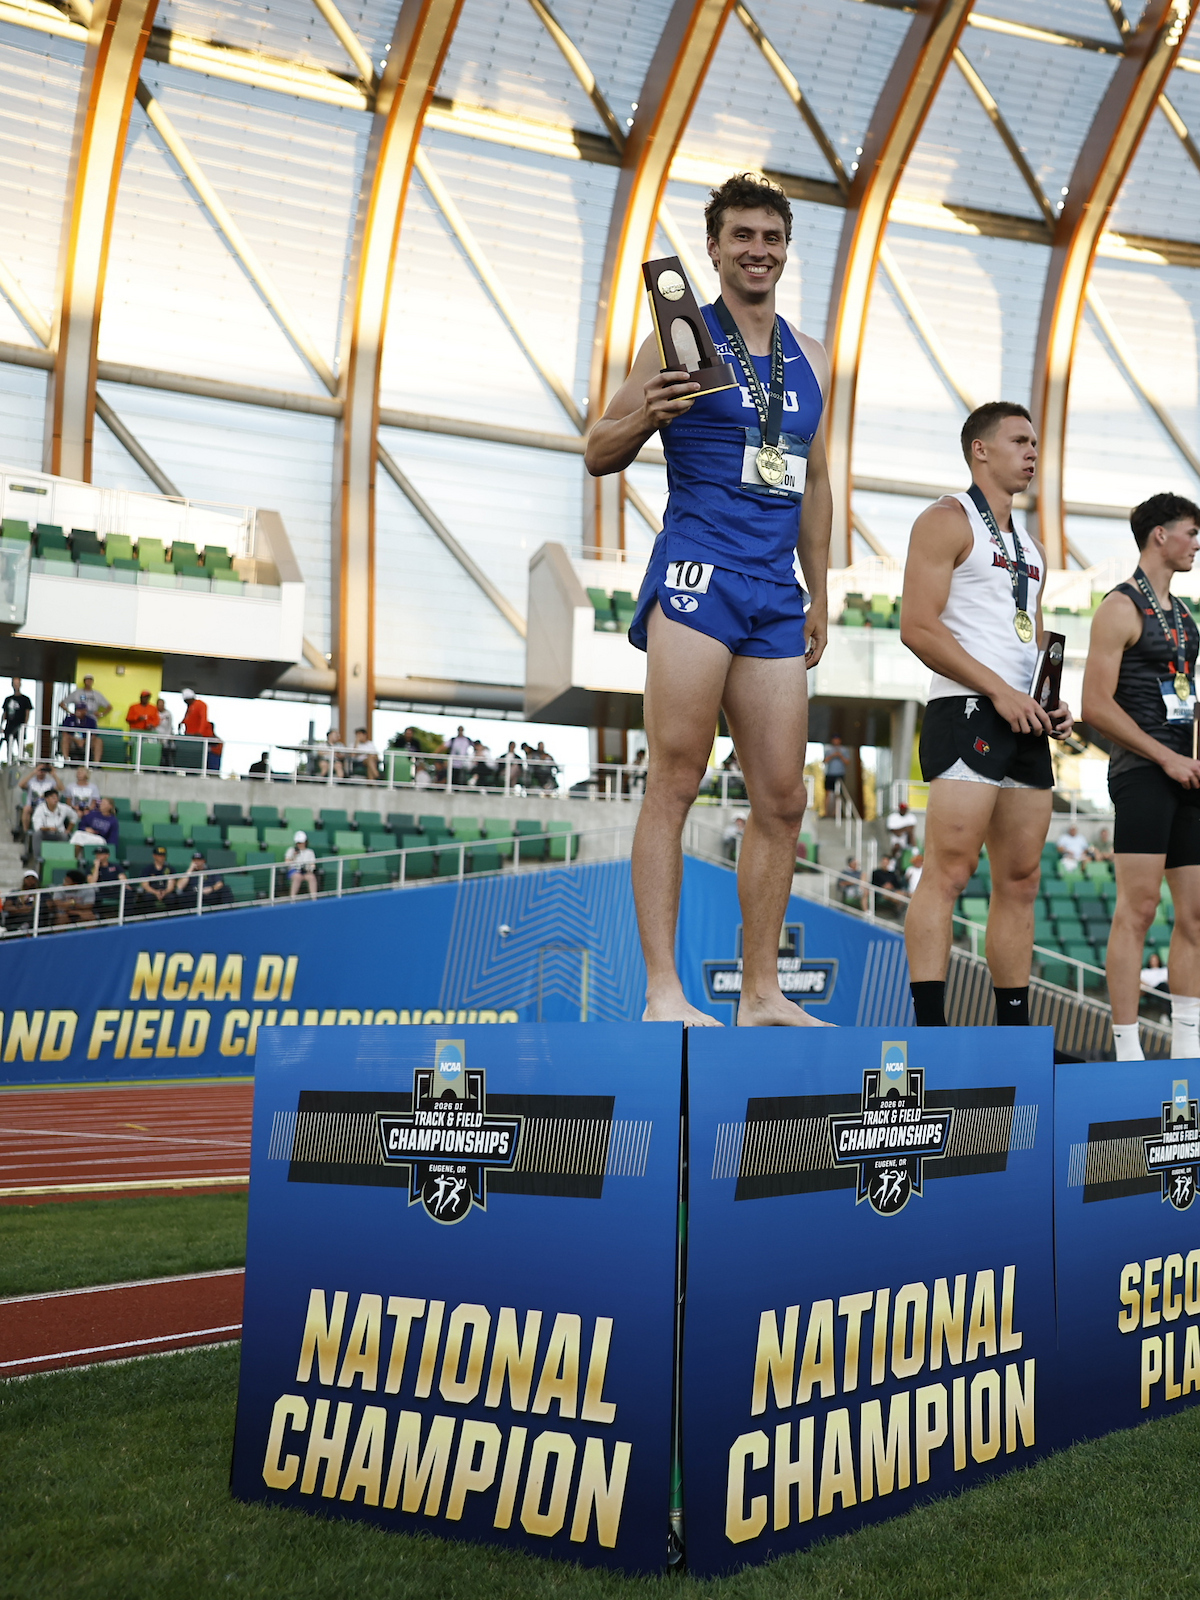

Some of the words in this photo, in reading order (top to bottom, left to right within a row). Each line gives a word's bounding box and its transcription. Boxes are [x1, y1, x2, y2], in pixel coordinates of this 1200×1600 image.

[726, 334, 767, 422] ALL-AMERICAN
[676, 561, 703, 588] 10
[130, 951, 245, 1001] NCAA
[253, 955, 299, 1001] DI
[0, 1010, 78, 1062] ND
[87, 1009, 211, 1060] FIELD
[440, 1062, 461, 1072] NCAA
[885, 1062, 904, 1072] NCAA
[434, 1102, 452, 1110] 2026
[863, 1109, 890, 1126] TRACK
[890, 1109, 897, 1124] &
[899, 1108, 921, 1123] FIELD
[880, 1101, 896, 1109] 2026
[415, 1111, 444, 1127] TRACK
[446, 1112, 455, 1127] &
[456, 1113, 483, 1128] FIELD
[389, 1128, 510, 1154] CHAMPIONSHIPS
[839, 1123, 943, 1151] CHAMPIONSHIPS
[1163, 1131, 1179, 1143] TRACK
[1184, 1130, 1198, 1141] FIELD
[429, 1164, 456, 1174] EUGENE,
[457, 1165, 466, 1173] OR
[875, 1160, 898, 1168] EUGENE,
[750, 1264, 1024, 1417] NATIONAL
[296, 1288, 618, 1424] NATIONAL
[724, 1358, 1036, 1545] CHAMPION
[262, 1393, 633, 1548] CHAMPION
